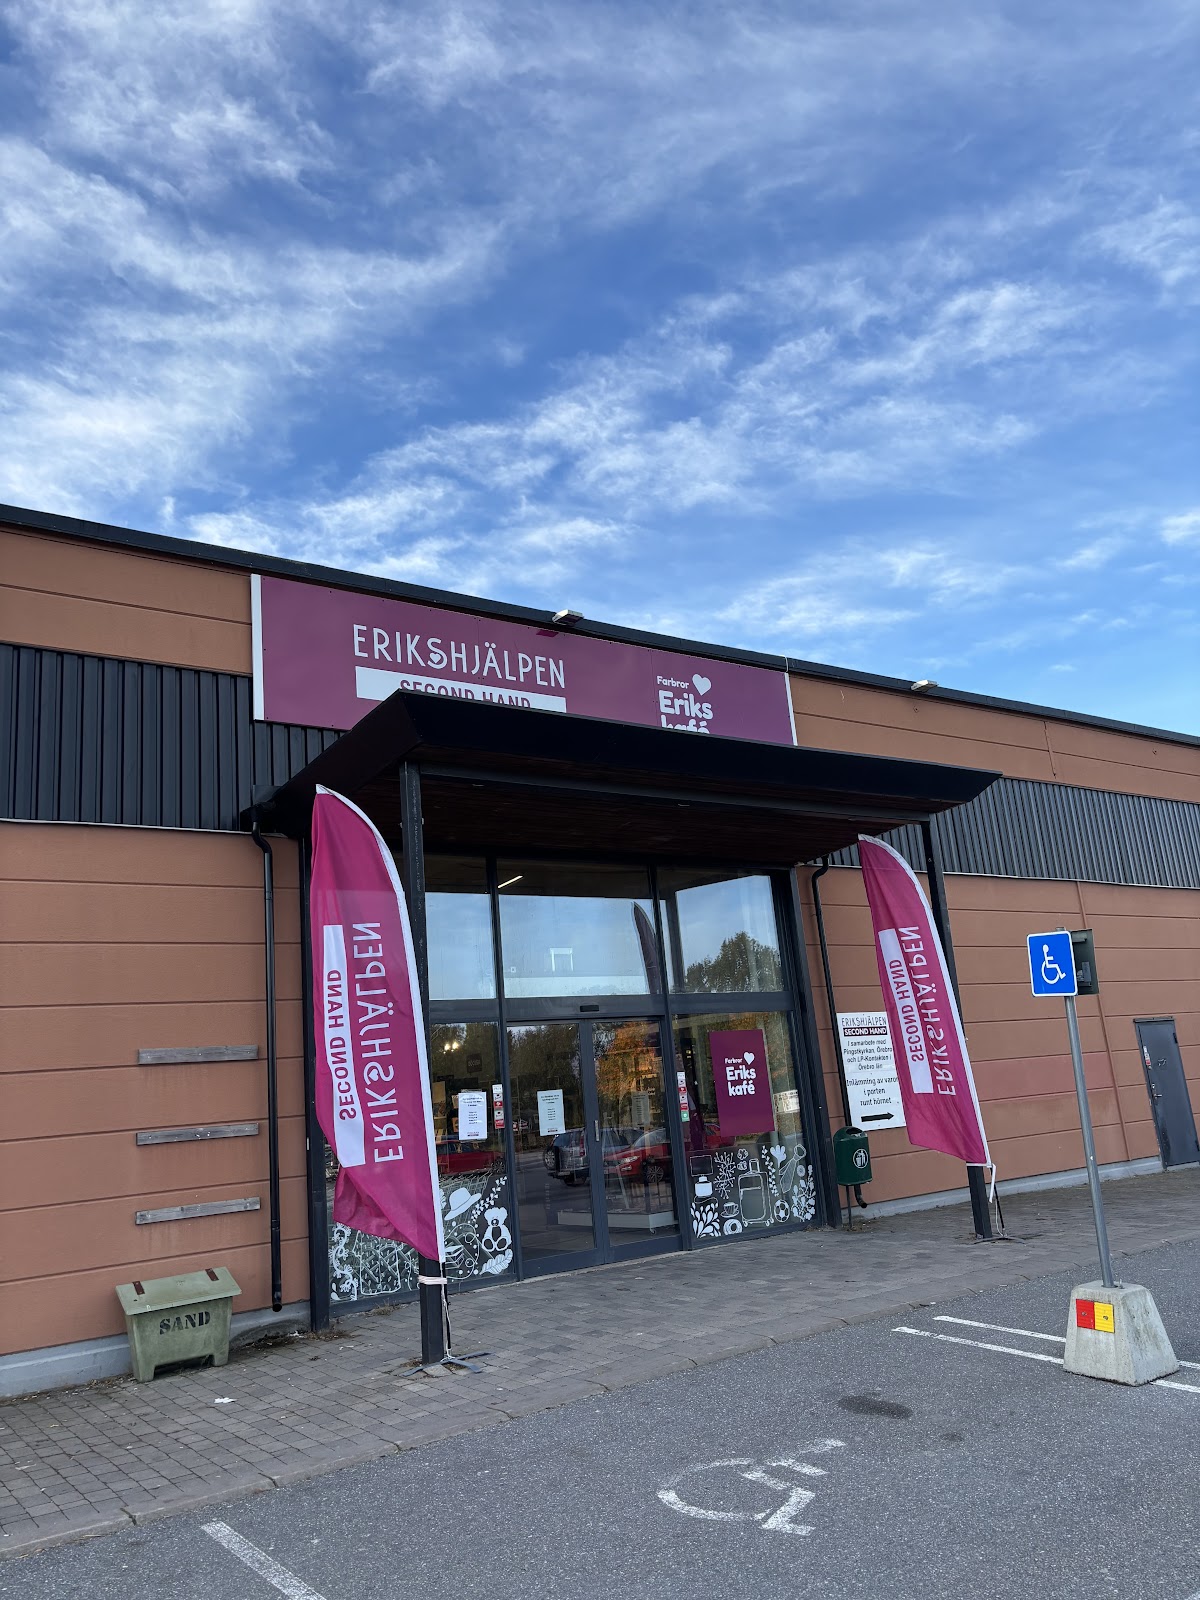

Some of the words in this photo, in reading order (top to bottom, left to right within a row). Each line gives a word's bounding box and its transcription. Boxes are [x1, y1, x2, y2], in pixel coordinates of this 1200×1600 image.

[353, 623, 565, 689] ERIKSHJÄLPEN
[656, 675, 690, 690] Farbror
[658, 689, 714, 720] Eriks
[841, 1015, 887, 1027] ERIKSHJÄLPEN
[844, 1028, 869, 1036] SECOND
[869, 1027, 887, 1035] HAND
[850, 1039, 875, 1047] samarbete
[724, 1057, 743, 1065] Farbror
[858, 1063, 875, 1071] Örebro
[726, 1065, 757, 1081] Eriks
[846, 1078, 877, 1087] Inlämning
[727, 1080, 756, 1097] kafé
[866, 1088, 886, 1097] porten
[873, 1097, 892, 1105] hörnet
[159, 1310, 211, 1335] SAND
